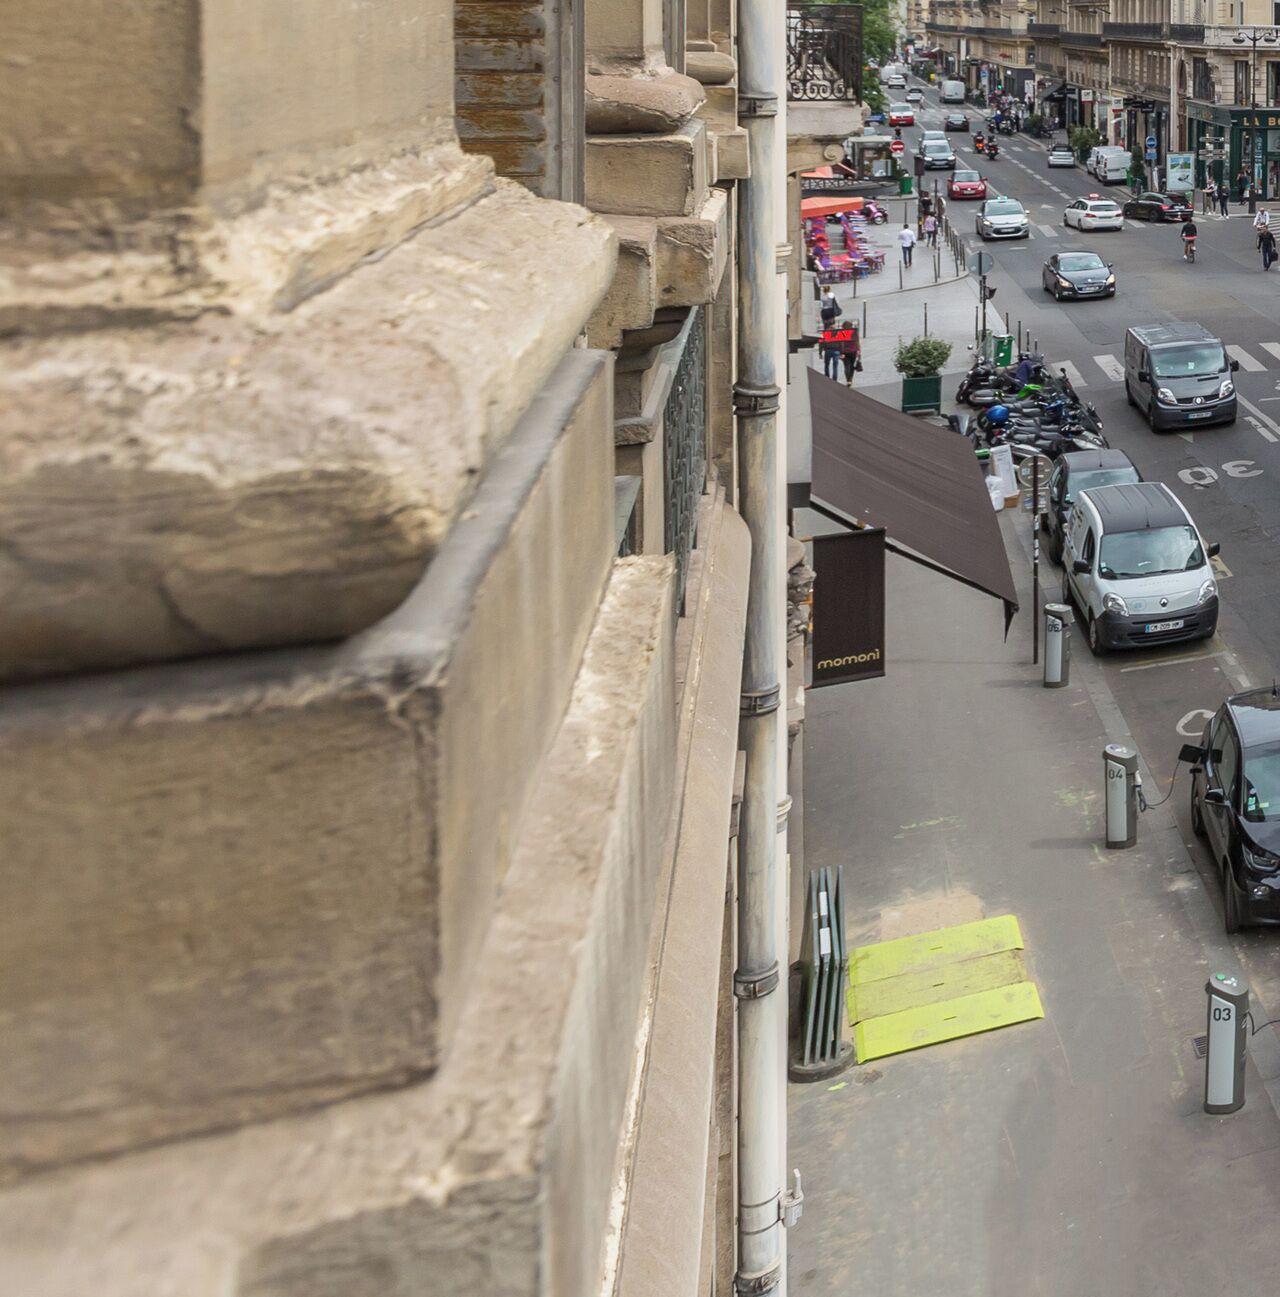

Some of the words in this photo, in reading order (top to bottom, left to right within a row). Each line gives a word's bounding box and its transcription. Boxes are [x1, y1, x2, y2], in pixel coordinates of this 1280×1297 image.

[1243, 117, 1260, 126] LA
[1108, 768, 1123, 780] 04
[1213, 1007, 1232, 1021] 03
